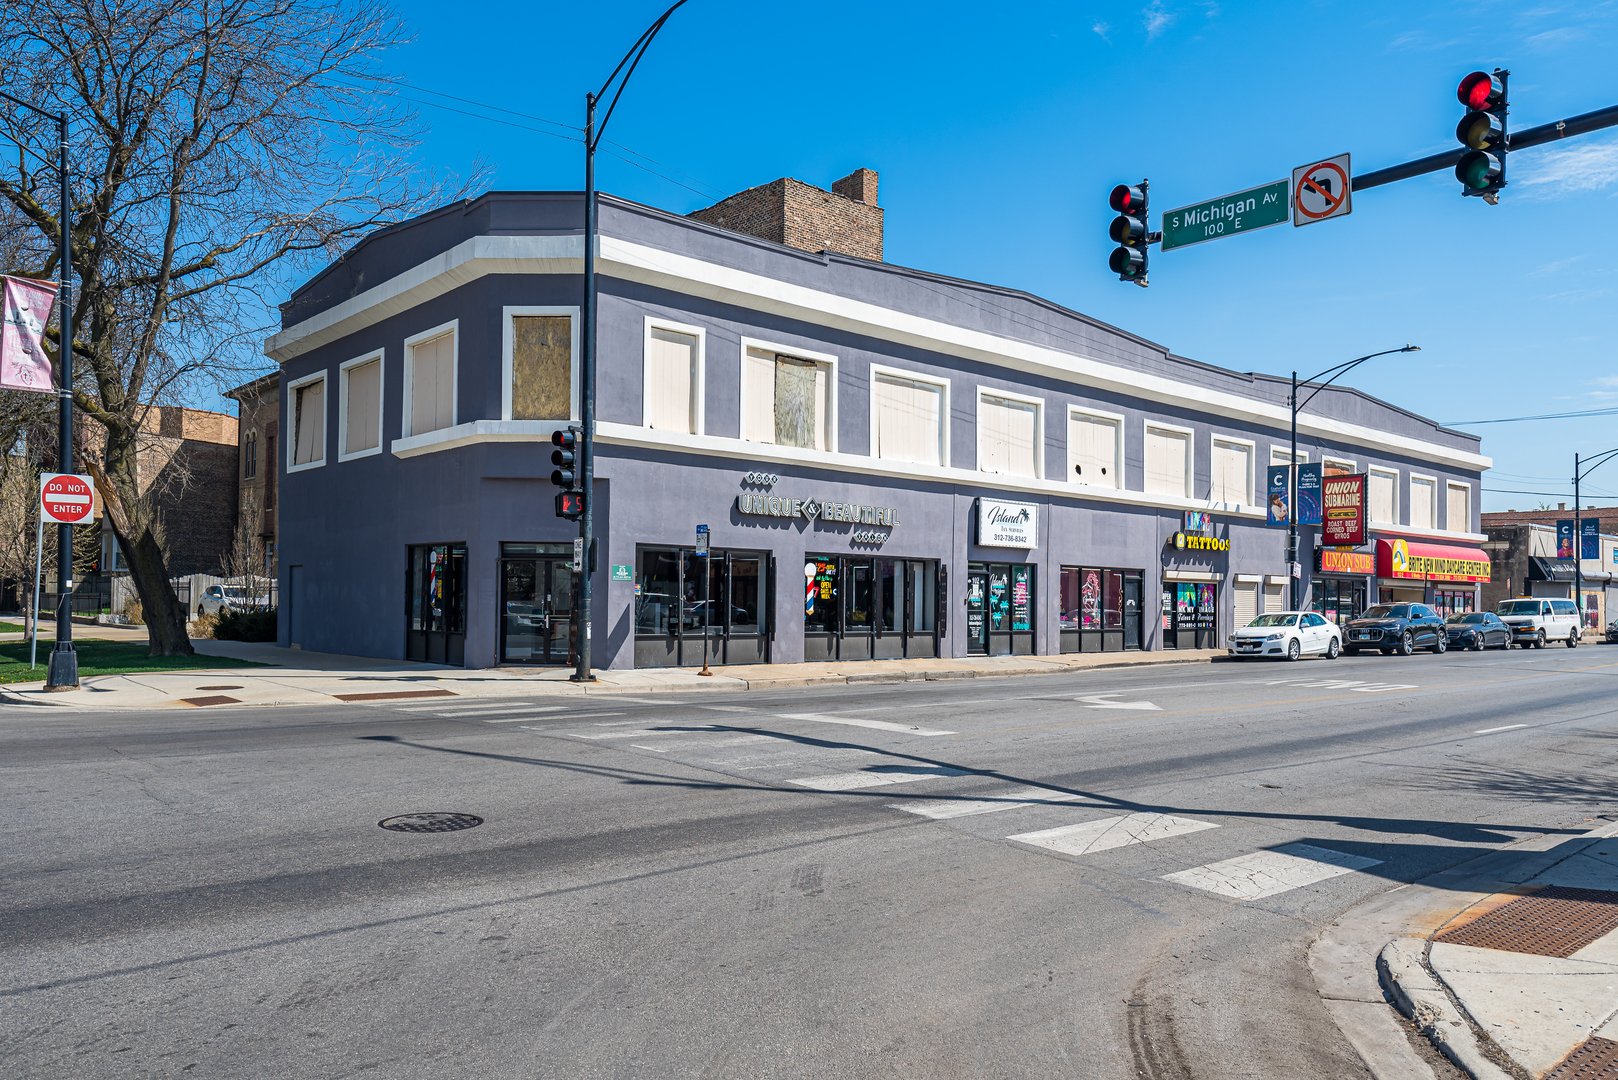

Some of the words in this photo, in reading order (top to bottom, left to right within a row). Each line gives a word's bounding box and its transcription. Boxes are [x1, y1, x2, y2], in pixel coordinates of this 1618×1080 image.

[1172, 217, 1179, 228] S
[1184, 198, 1256, 227] Michigan
[1262, 193, 1278, 204] Av
[1204, 222, 1224, 236] 100
[1235, 217, 1242, 229] E
[49, 483, 63, 492] DO
[68, 484, 86, 493] NOT
[1325, 481, 1360, 495] UNION
[576, 497, 582, 511] 5
[1325, 493, 1361, 508] SUBMARINE
[53, 504, 83, 514] ENTER
[739, 493, 801, 517] UNIQUE
[821, 501, 900, 526] BEAUTIFUL
[988, 505, 1022, 525] Island
[1326, 526, 1345, 534] CORNED
[1186, 535, 1231, 551] TATTOOS
[1325, 552, 1354, 568] UNION
[1355, 554, 1371, 569] SUB
[1408, 556, 1422, 572] BRITE
[1423, 557, 1434, 573] NEW
[1434, 558, 1446, 573] MIND
[1446, 559, 1466, 575] DAYCARE
[1466, 560, 1481, 576] CENTER
